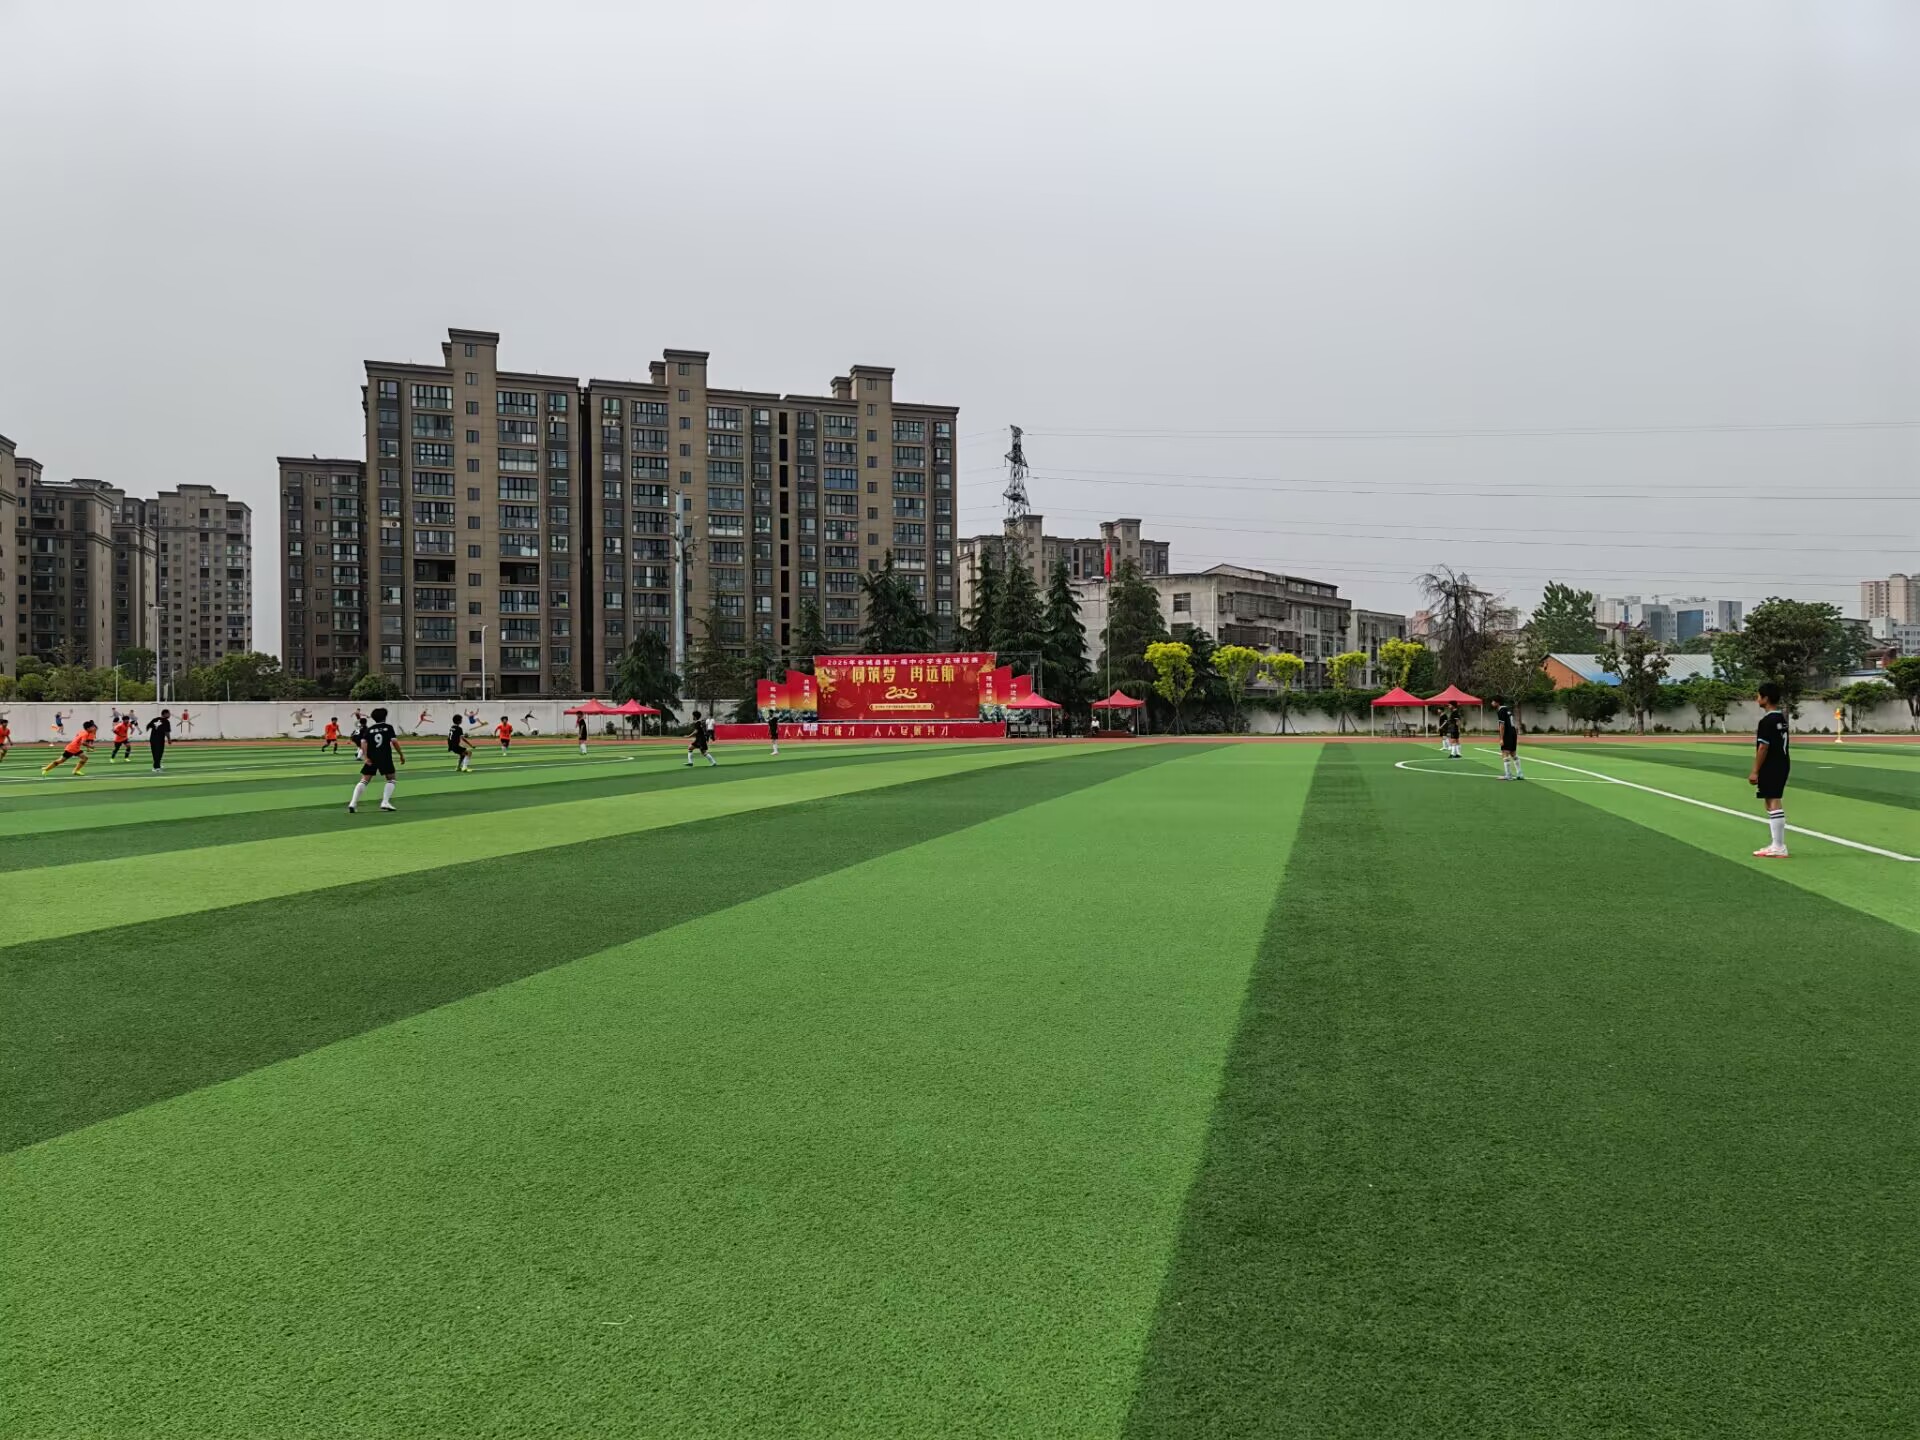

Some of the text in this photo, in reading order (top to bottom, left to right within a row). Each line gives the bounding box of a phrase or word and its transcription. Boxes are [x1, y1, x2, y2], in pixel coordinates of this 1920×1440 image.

[852, 666, 896, 684] 同筑梦
[885, 686, 918, 700] 2025
[374, 733, 384, 748] 9
